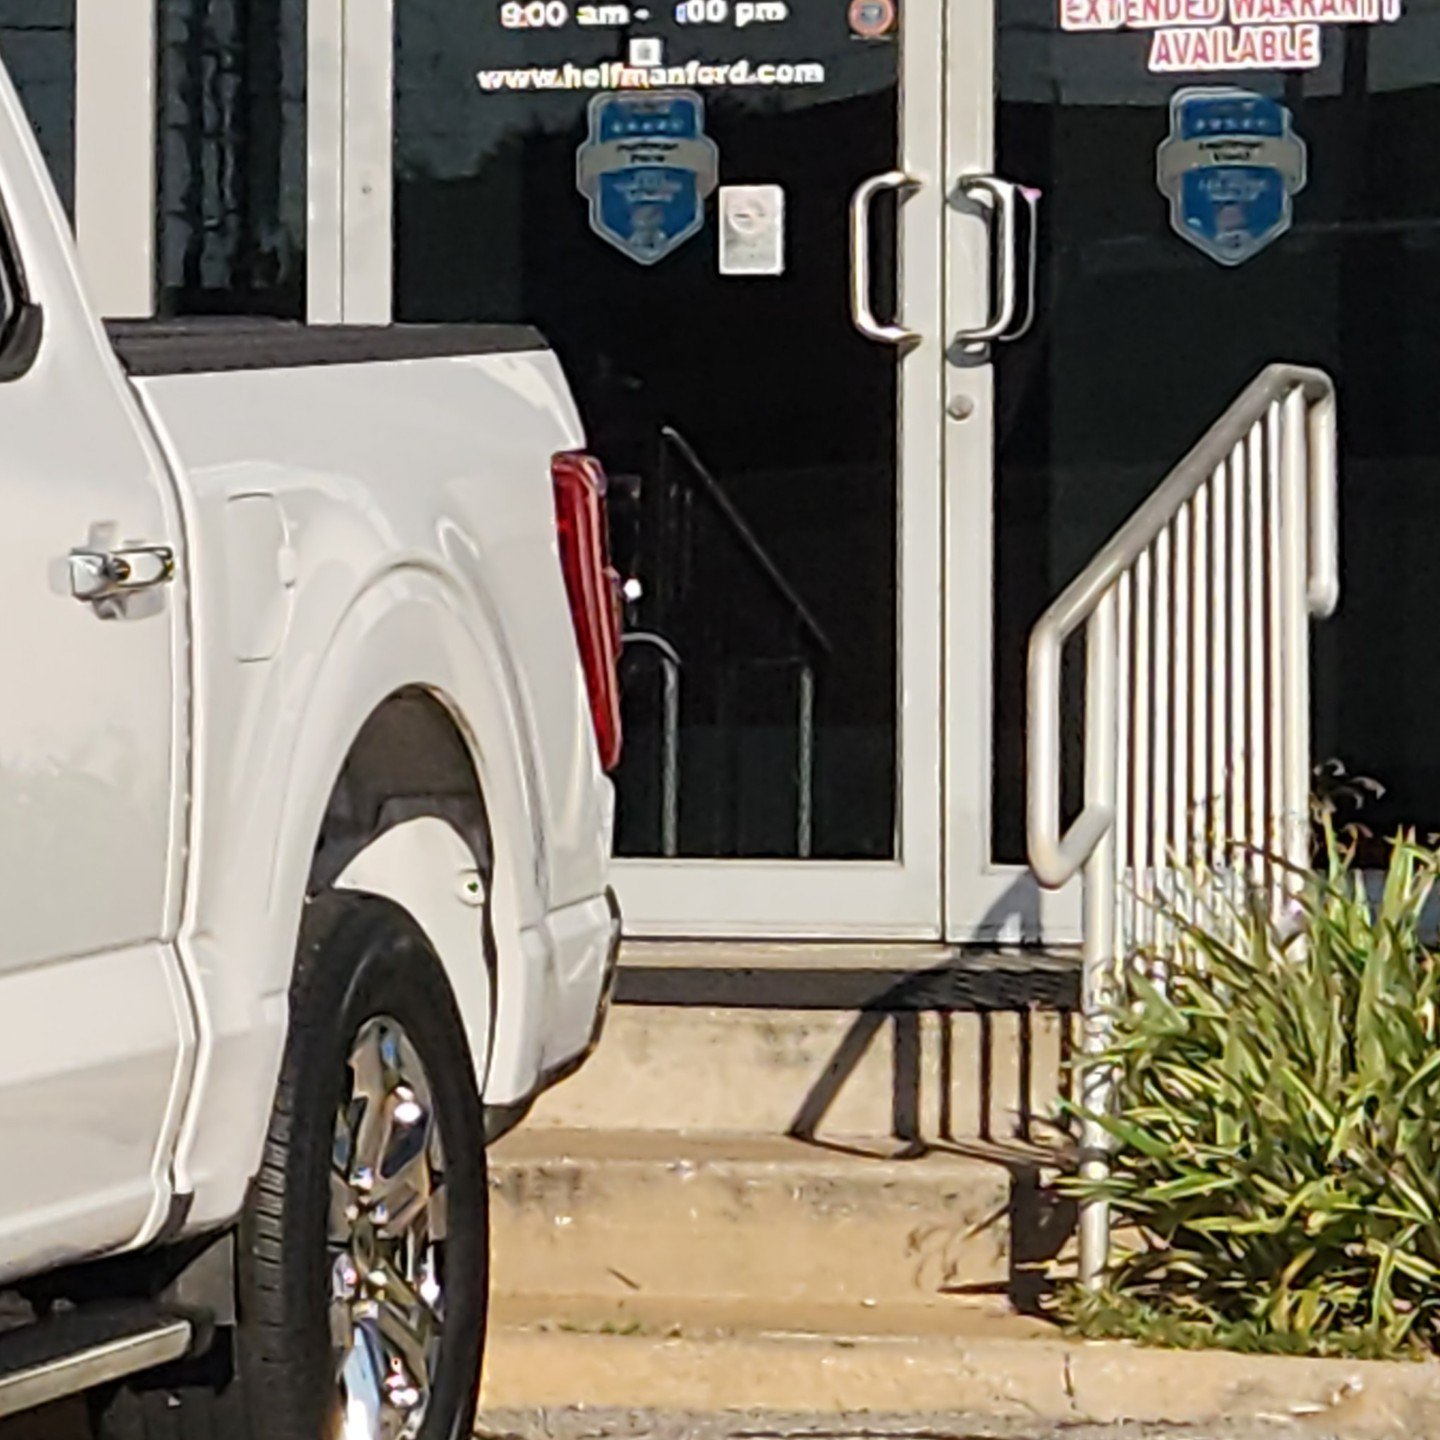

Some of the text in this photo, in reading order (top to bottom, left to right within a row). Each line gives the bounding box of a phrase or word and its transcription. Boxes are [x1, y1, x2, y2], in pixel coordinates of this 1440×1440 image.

[576, 6, 630, 26] am
[735, 1, 788, 27] pm
[1152, 27, 1318, 65] AVAILABLE
